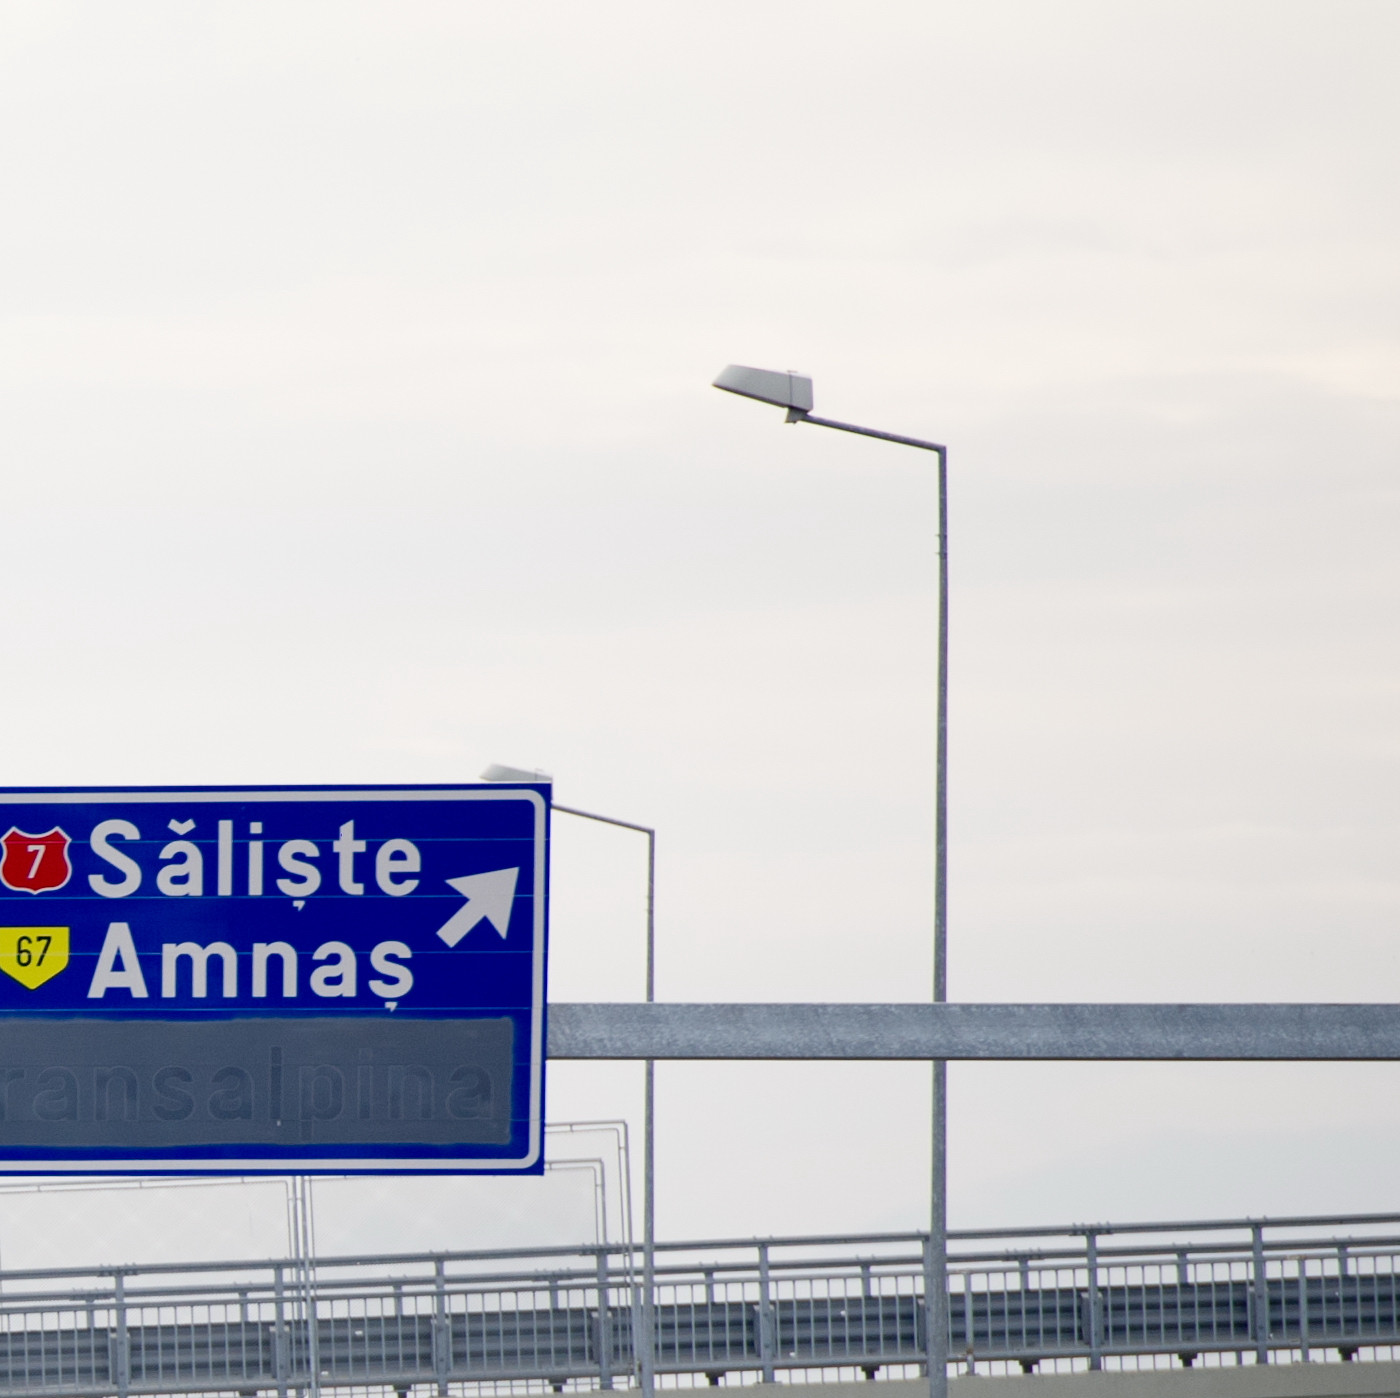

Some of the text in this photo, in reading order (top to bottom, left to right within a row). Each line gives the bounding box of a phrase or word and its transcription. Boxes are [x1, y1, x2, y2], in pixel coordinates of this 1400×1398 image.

[27, 844, 46, 879] 7
[87, 818, 422, 911] Săliște
[15, 922, 415, 1012] 67 Amnaș
